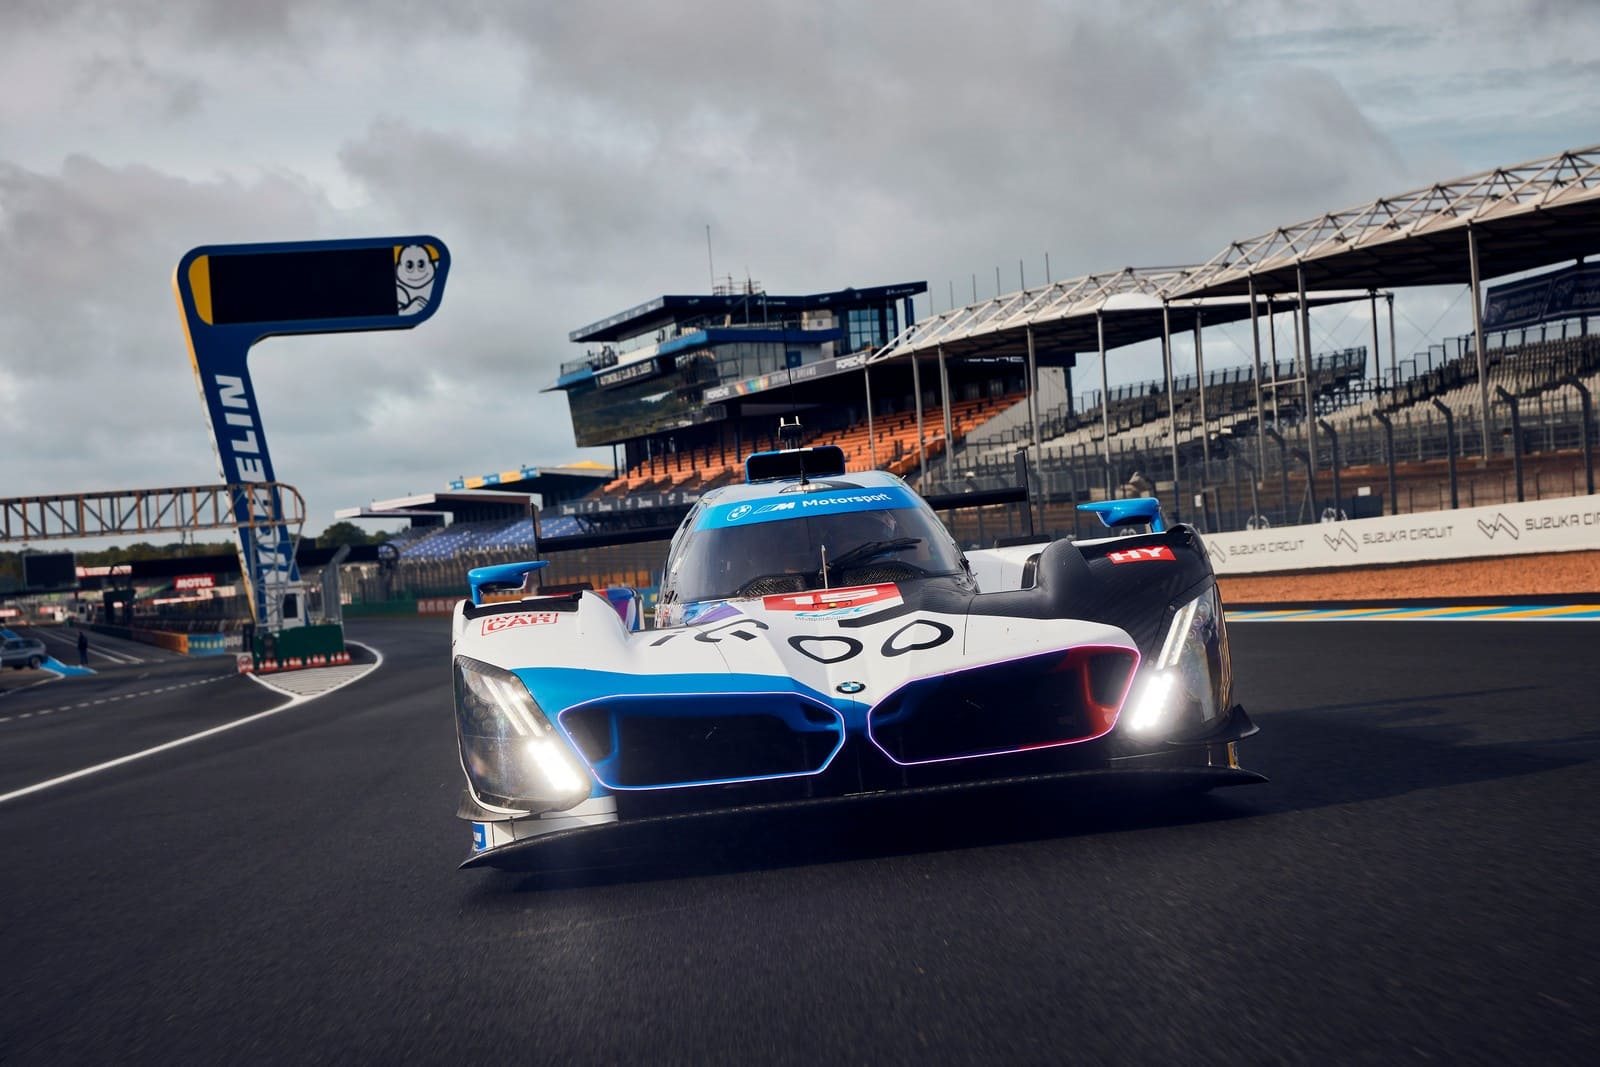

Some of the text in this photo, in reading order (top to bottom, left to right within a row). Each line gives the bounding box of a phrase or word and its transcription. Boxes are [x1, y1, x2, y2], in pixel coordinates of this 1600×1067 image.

[803, 493, 892, 508] Motorsport
[1525, 514, 1580, 531] SUZUKA
[1363, 526, 1453, 545] SUZUKA CIRCUIT
[1110, 547, 1164, 560] HY
[1230, 539, 1304, 556] SUZUKA CIRCUIT
[176, 577, 214, 589] MOTUL
